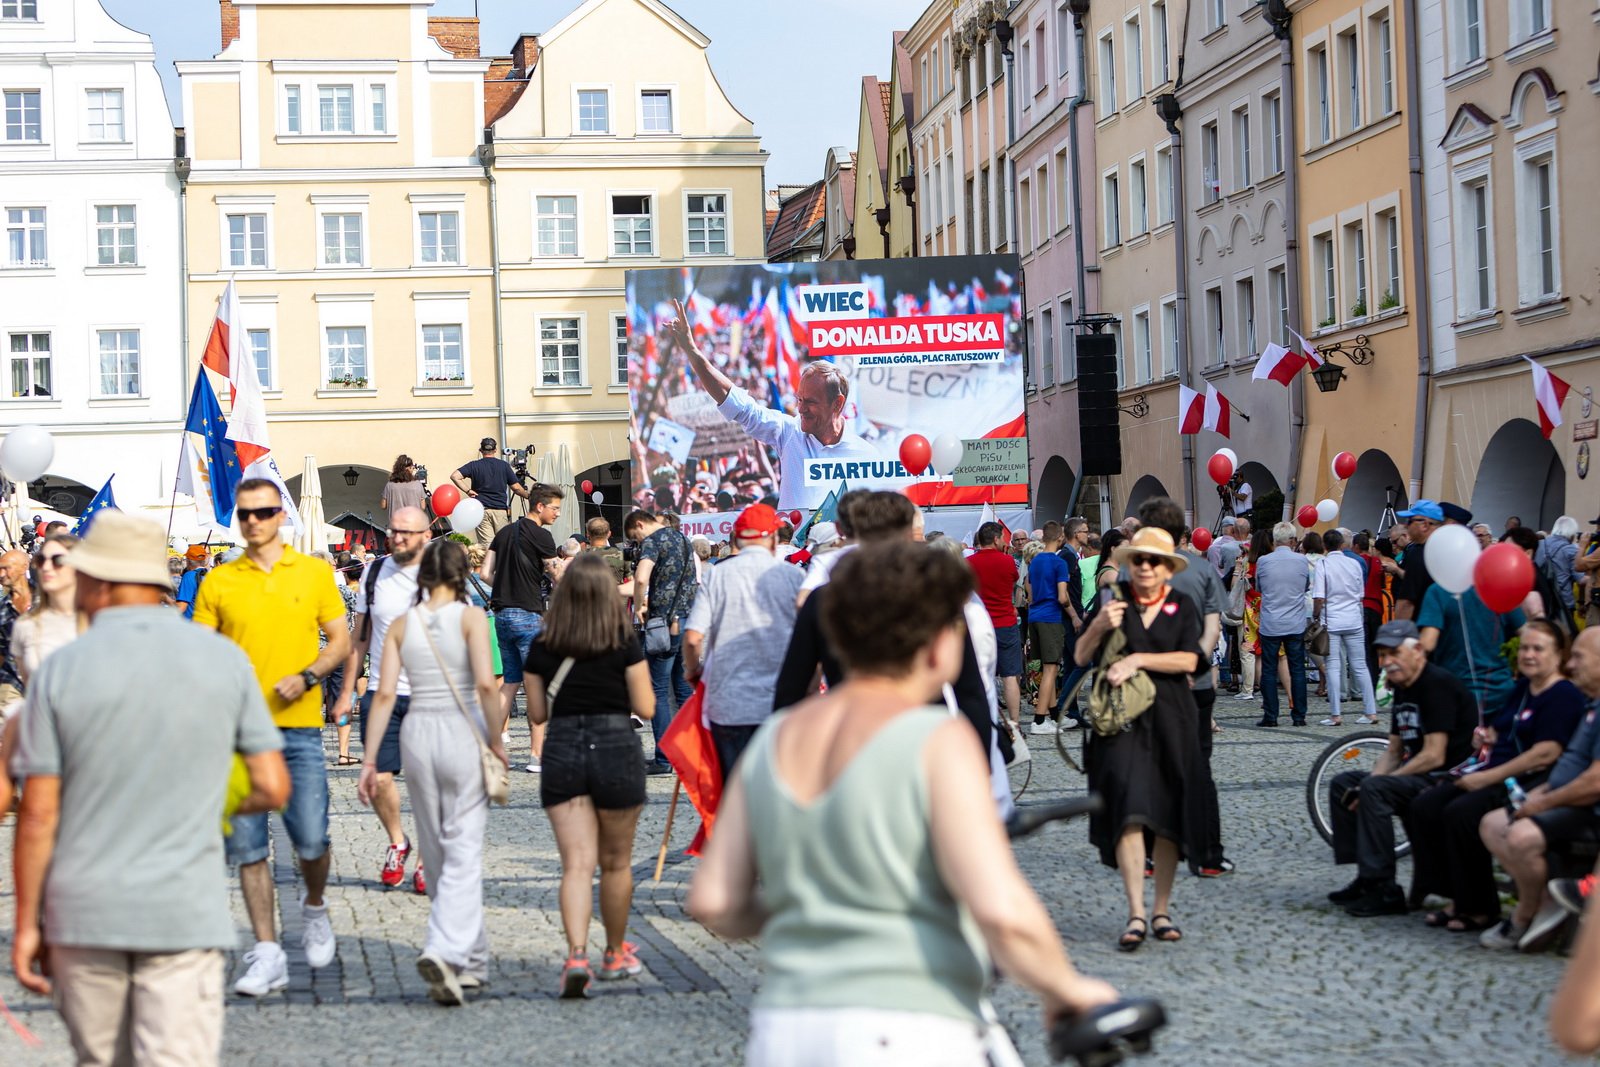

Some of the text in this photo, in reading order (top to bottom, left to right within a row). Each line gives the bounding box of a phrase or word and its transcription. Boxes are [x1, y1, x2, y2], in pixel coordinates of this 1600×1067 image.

[803, 291, 864, 313] WIEC
[811, 321, 1000, 349] DONALDA TUSKA
[858, 352, 1000, 366] JELENIA GÓRA, PLAC RATUSZOWY
[967, 441, 990, 451] MAM
[974, 473, 1010, 484] POLAKÓW
